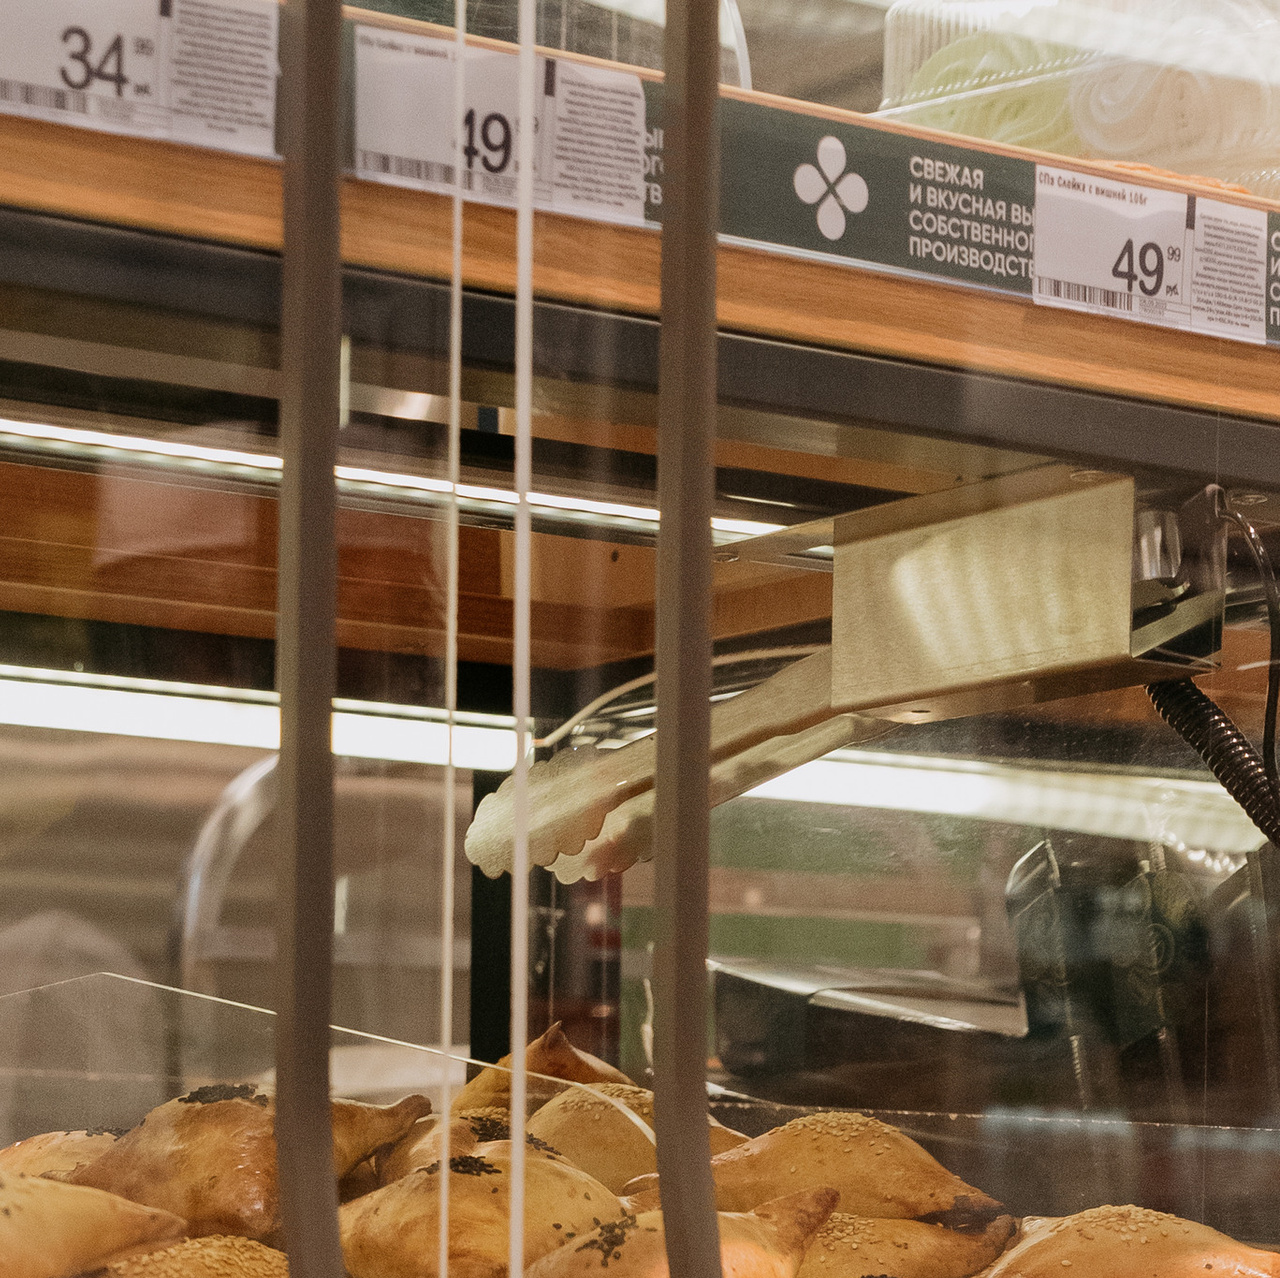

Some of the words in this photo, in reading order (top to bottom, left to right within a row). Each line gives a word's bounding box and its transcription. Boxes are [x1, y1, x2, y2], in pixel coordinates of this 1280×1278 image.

[59, 26, 128, 97] 34
[910, 156, 984, 190] СВЕЖАЯ
[910, 183, 922, 204] И
[927, 186, 1007, 221] ВКУСНАЯ
[1112, 238, 1164, 297] 49
[1167, 246, 1181, 262] 99
